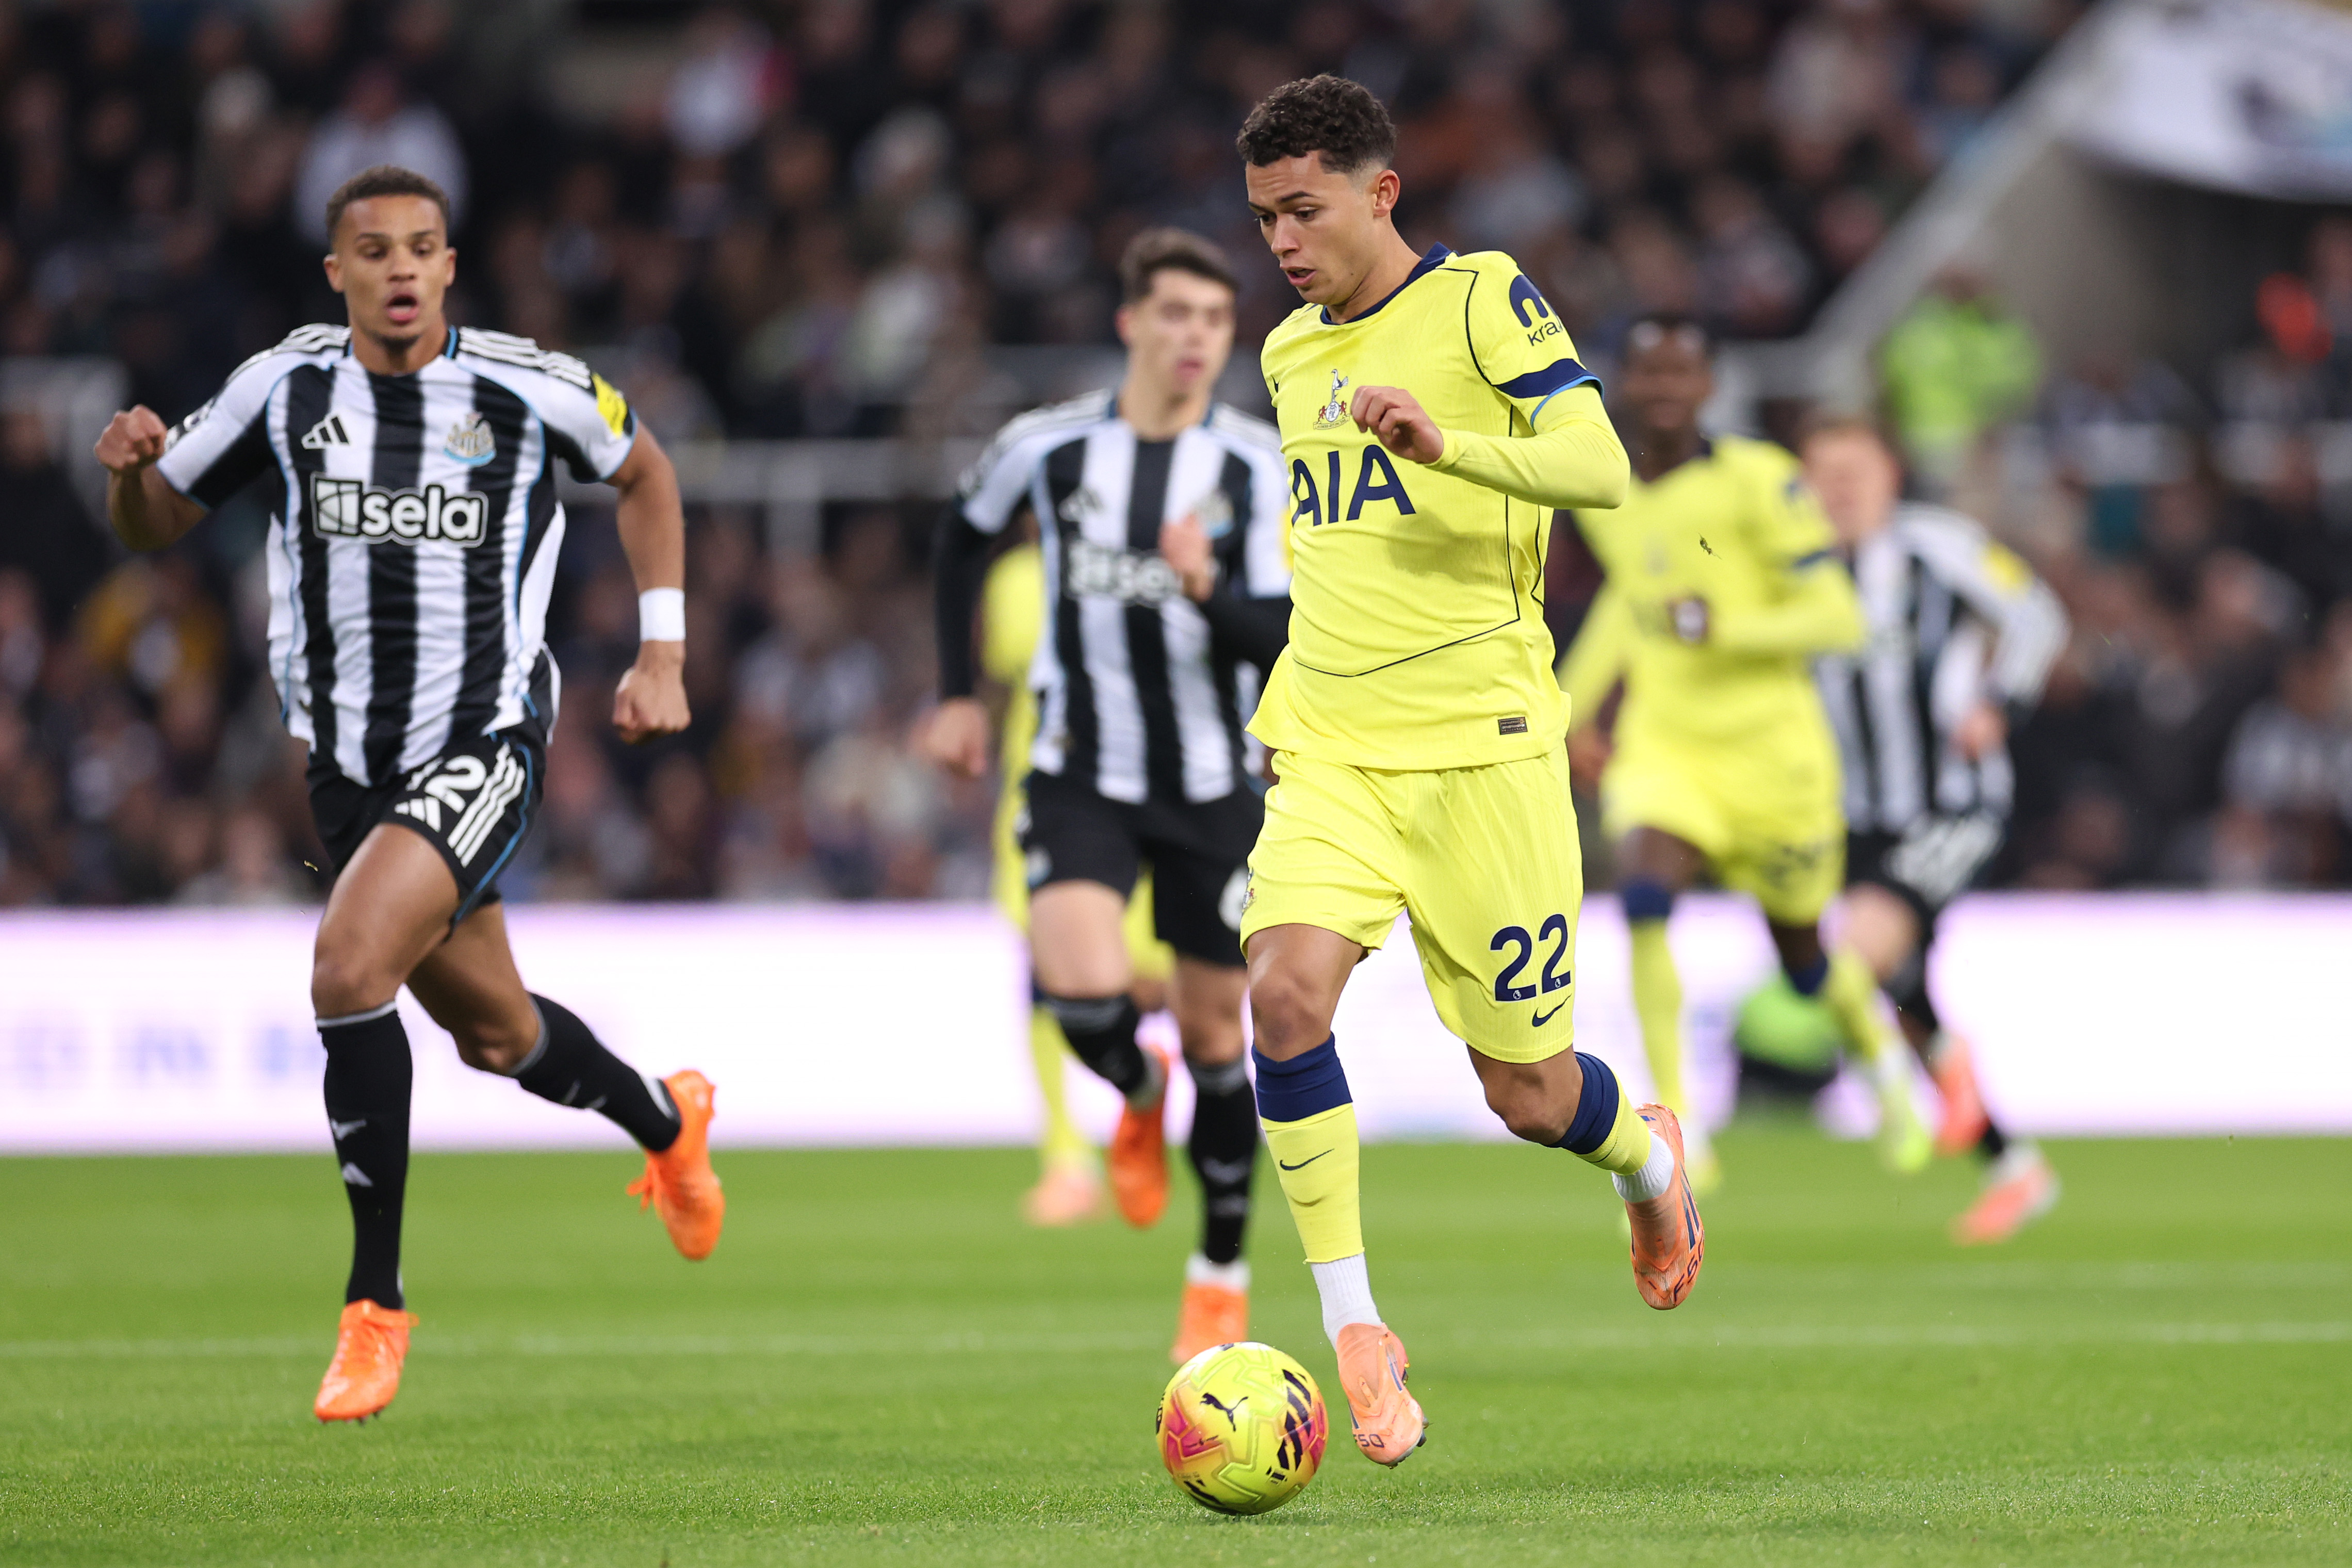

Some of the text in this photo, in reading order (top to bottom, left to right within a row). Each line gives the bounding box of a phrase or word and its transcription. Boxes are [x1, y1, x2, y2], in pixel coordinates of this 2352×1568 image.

[361, 485, 481, 540] sela
[1291, 444, 1416, 528] AIA
[1490, 913, 1571, 1002] 22
